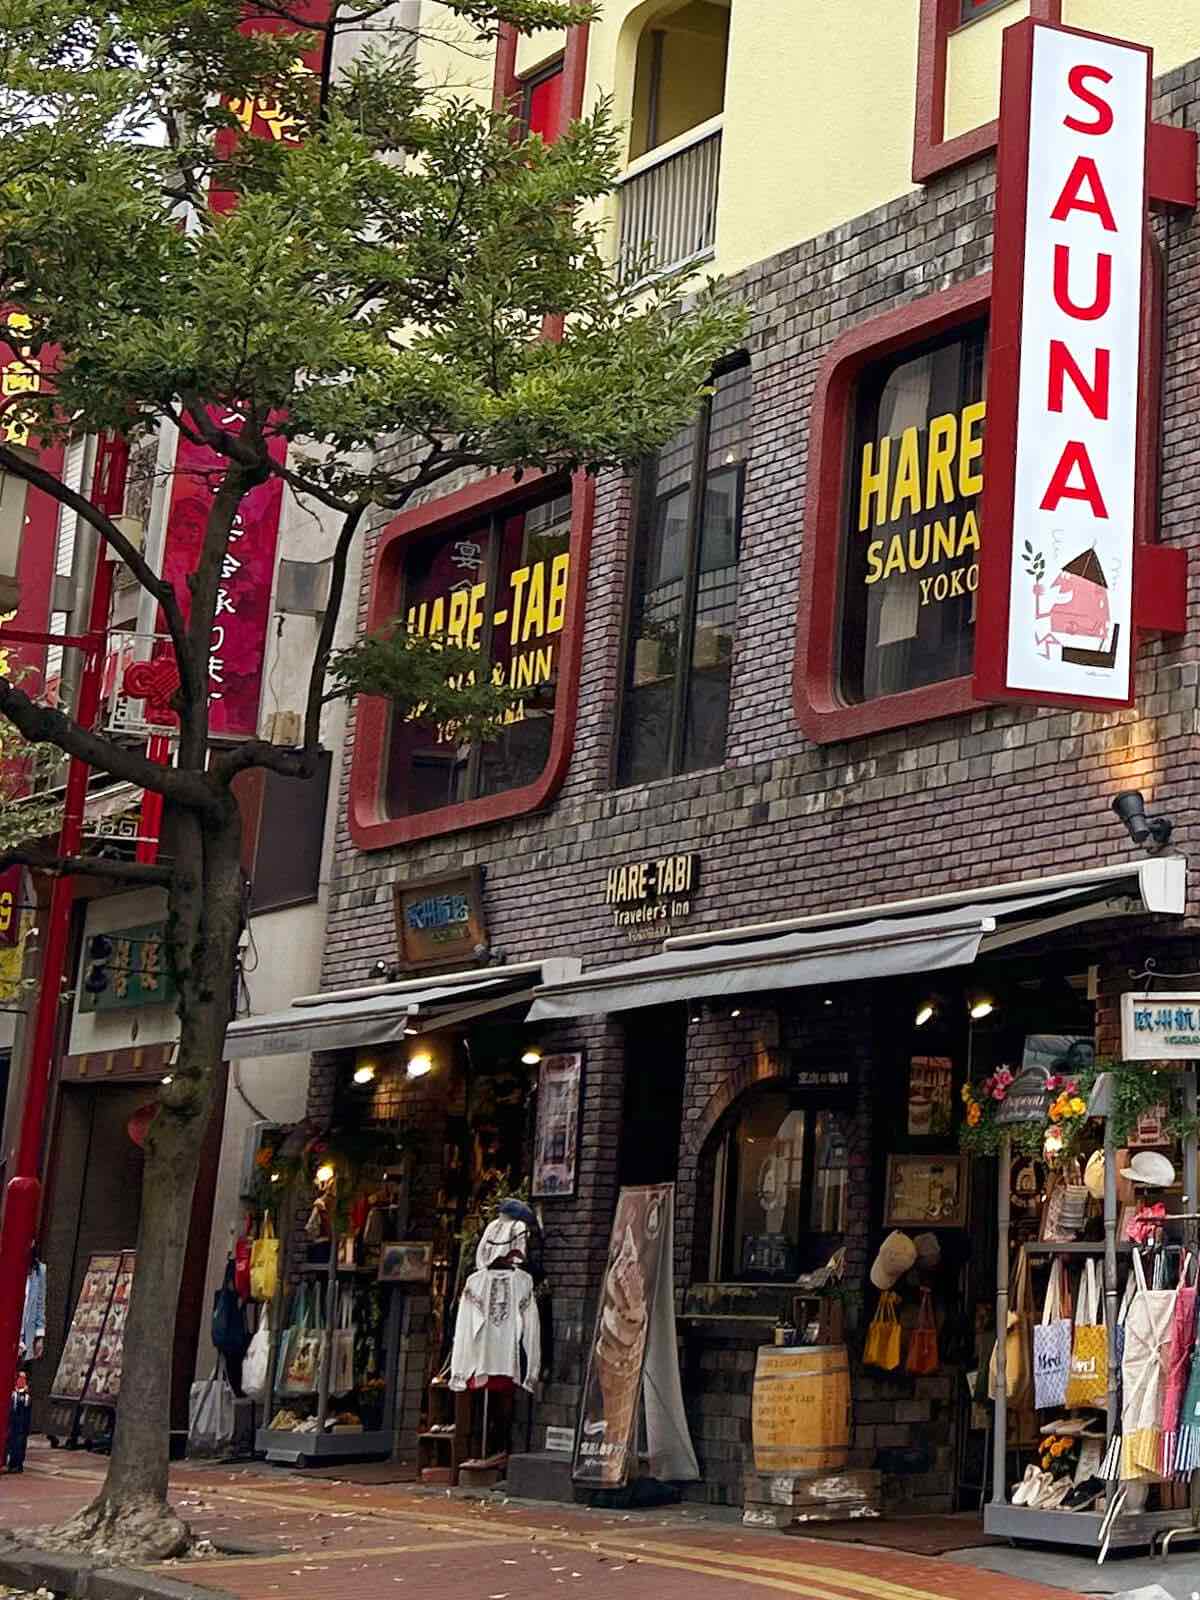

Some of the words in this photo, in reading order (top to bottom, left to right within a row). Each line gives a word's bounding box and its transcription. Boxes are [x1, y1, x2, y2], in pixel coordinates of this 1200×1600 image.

[1040, 64, 1118, 519] SAUNA
[859, 401, 986, 531] HARE
[865, 510, 980, 584] SAUNA
[511, 646, 554, 690] INN
[606, 855, 692, 904] HARE-TABI
[671, 900, 690, 917] Inn
